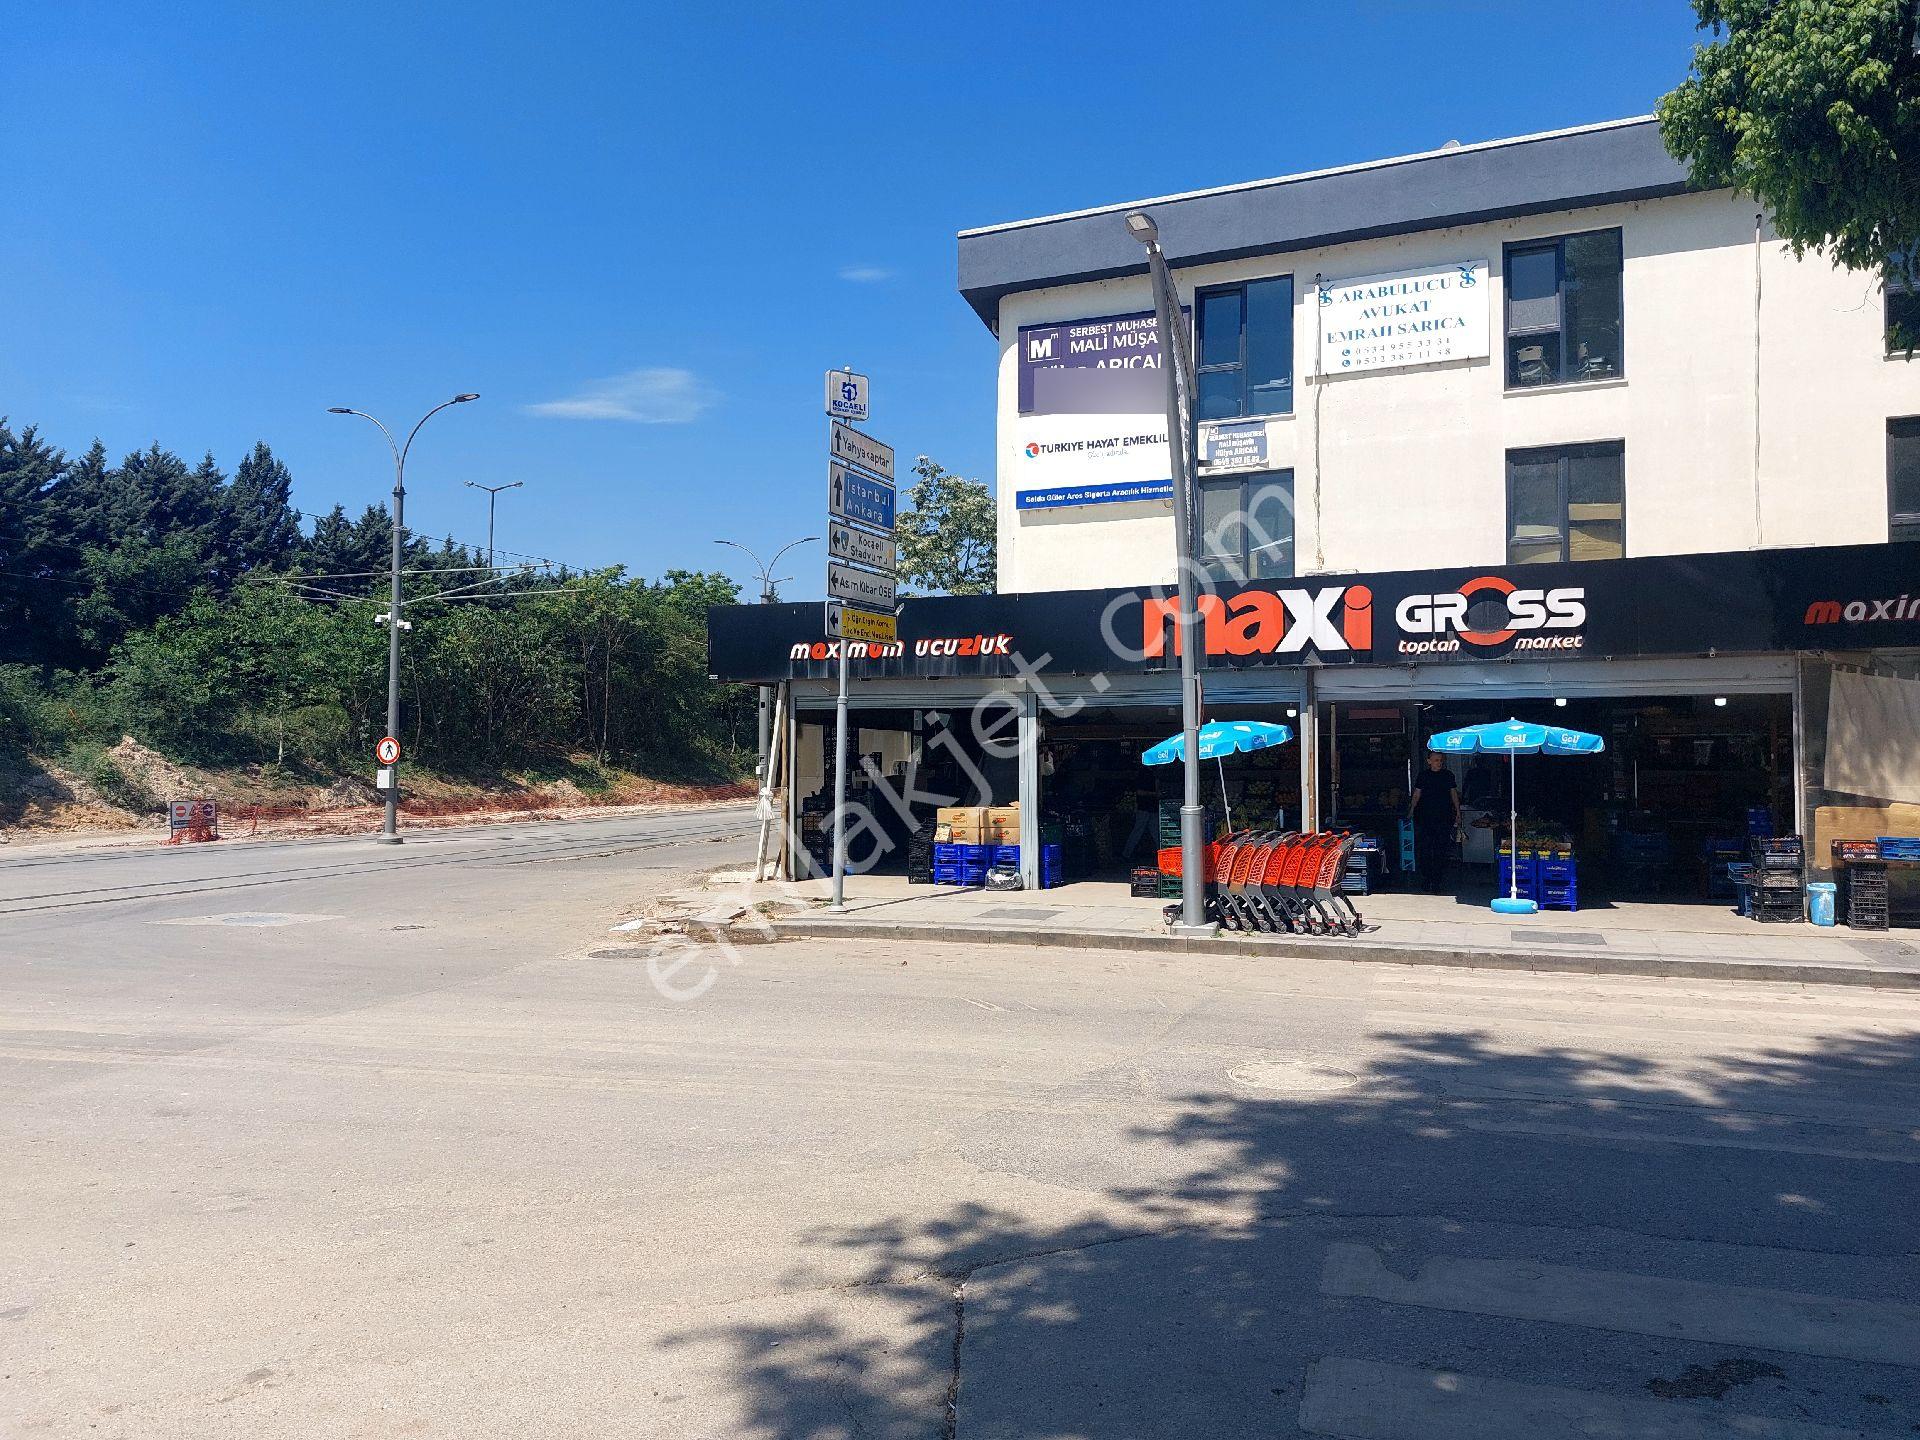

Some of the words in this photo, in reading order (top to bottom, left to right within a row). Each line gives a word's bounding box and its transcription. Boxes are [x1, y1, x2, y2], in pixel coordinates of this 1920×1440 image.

[1339, 278, 1452, 303] ARABULUCU
[1359, 299, 1432, 320] AVUKAT
[1069, 323, 1113, 338] SERBEST
[1070, 333, 1108, 354] MALİ
[1112, 328, 1159, 349] MÜŞA
[1327, 325, 1392, 344] EMRAH
[1397, 316, 1466, 335] SARICA
[1087, 437, 1120, 450] HAYAT
[846, 475, 890, 508] İstanbul
[846, 498, 883, 523] Ankara
[1394, 576, 1587, 645] GROSS
[789, 640, 905, 661] maxmum
[914, 634, 1014, 658] ucuzluk
[1398, 639, 1460, 655] toptan
[1514, 634, 1583, 650] market
